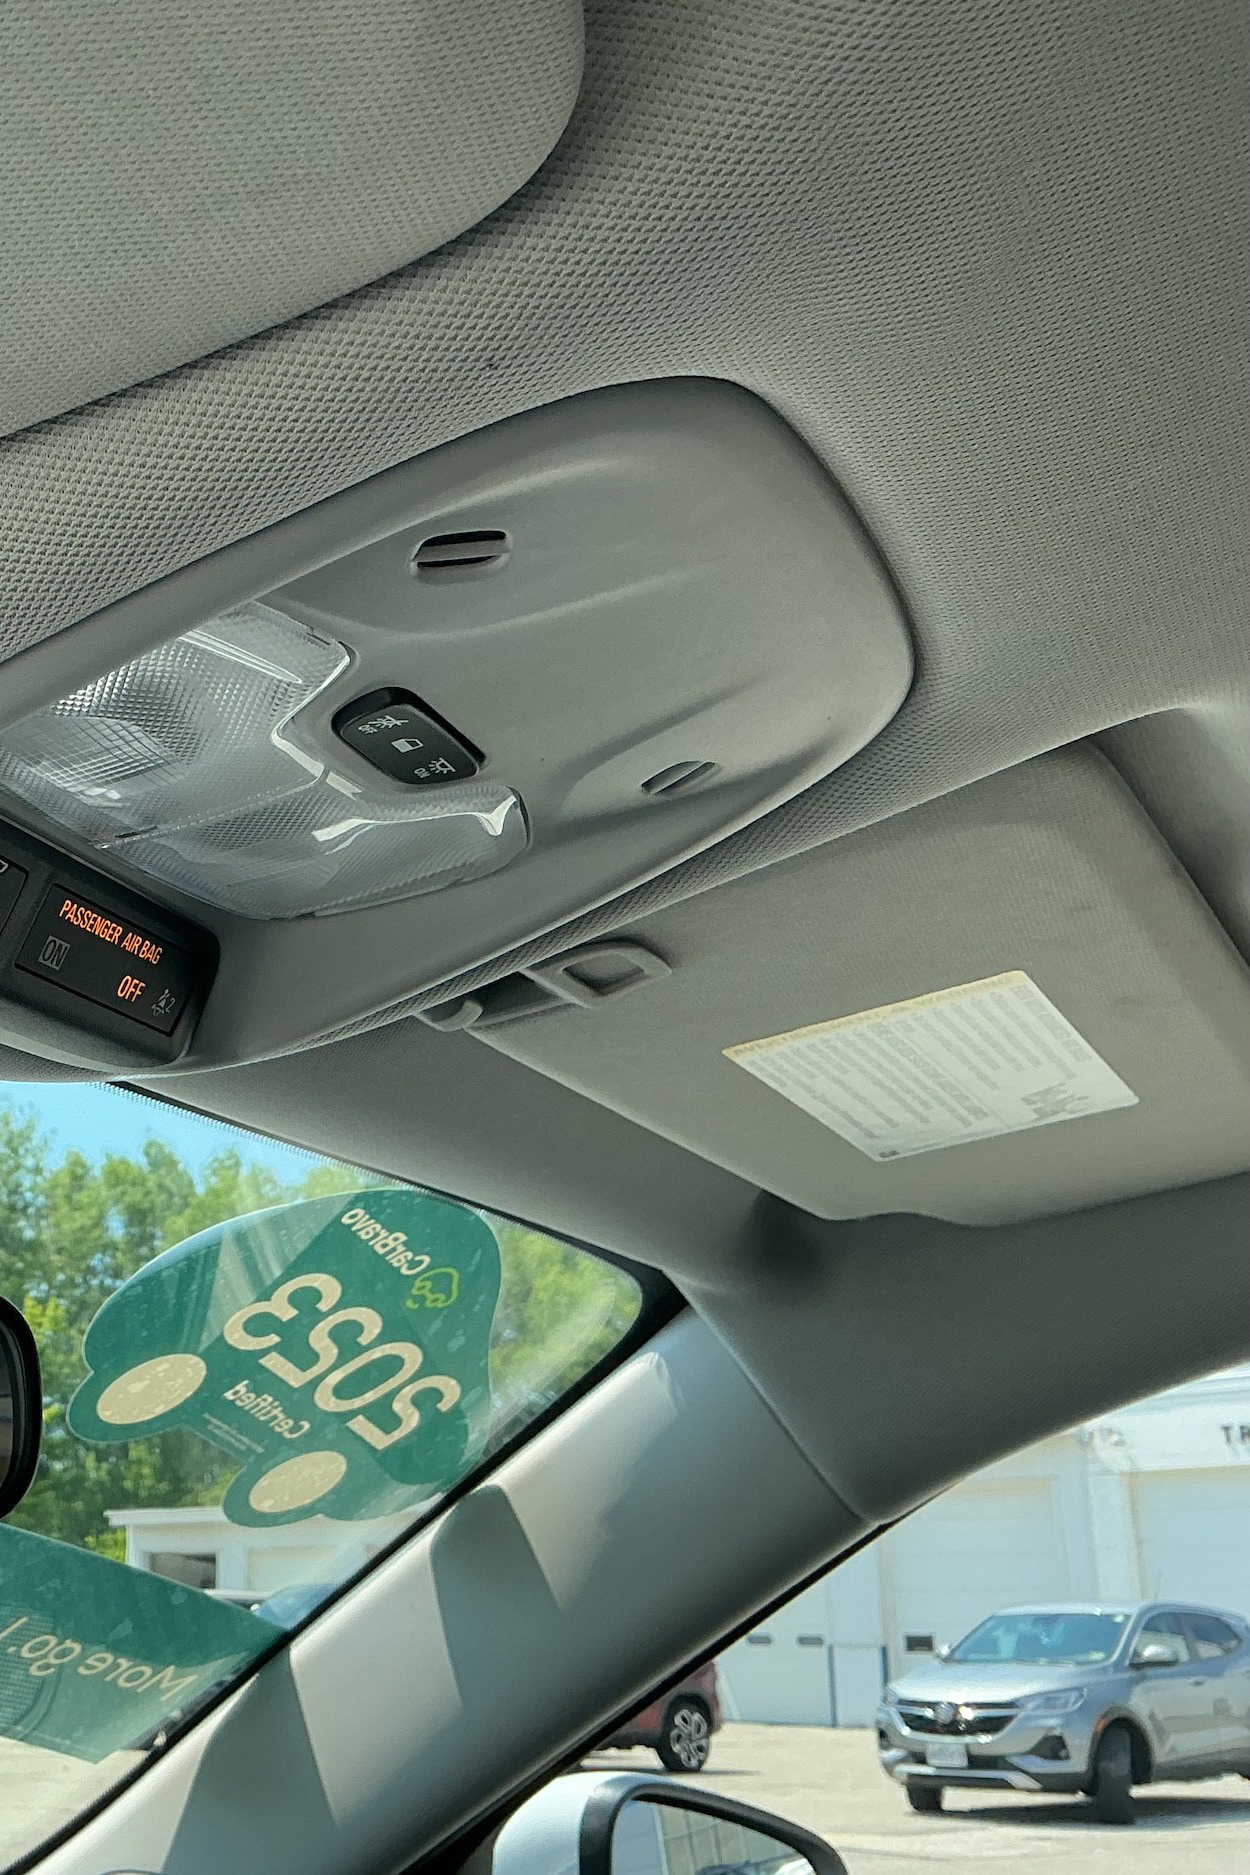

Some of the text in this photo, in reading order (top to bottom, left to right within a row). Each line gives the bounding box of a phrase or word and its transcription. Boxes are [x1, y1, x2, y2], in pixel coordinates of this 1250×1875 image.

[413, 767, 431, 779] ON
[58, 899, 163, 965] PASSENGER AIR BAG
[39, 937, 68, 971] ON
[116, 974, 146, 1003] OFF
